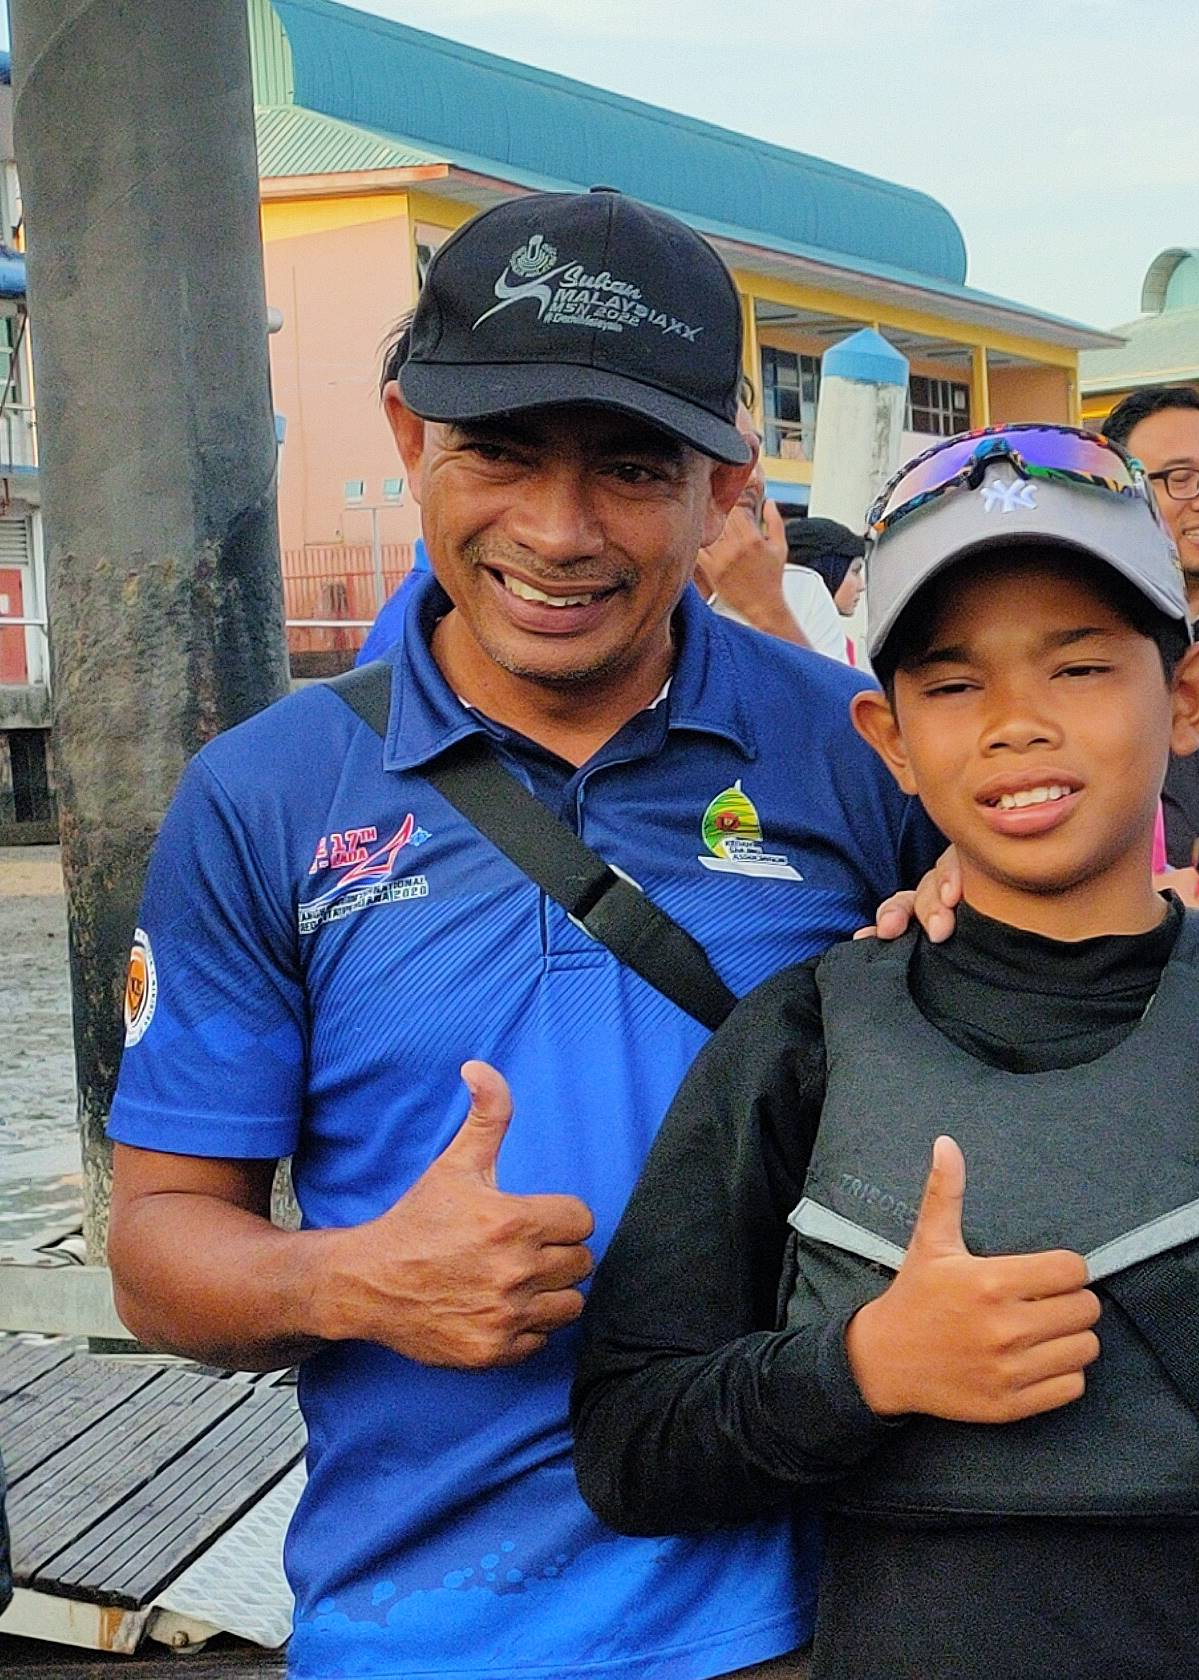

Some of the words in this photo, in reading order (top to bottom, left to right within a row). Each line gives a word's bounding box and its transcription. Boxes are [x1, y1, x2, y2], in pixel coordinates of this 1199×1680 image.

[549, 302, 591, 320] MSN
[593, 305, 641, 327] 2022
[393, 884, 429, 900] 2020
